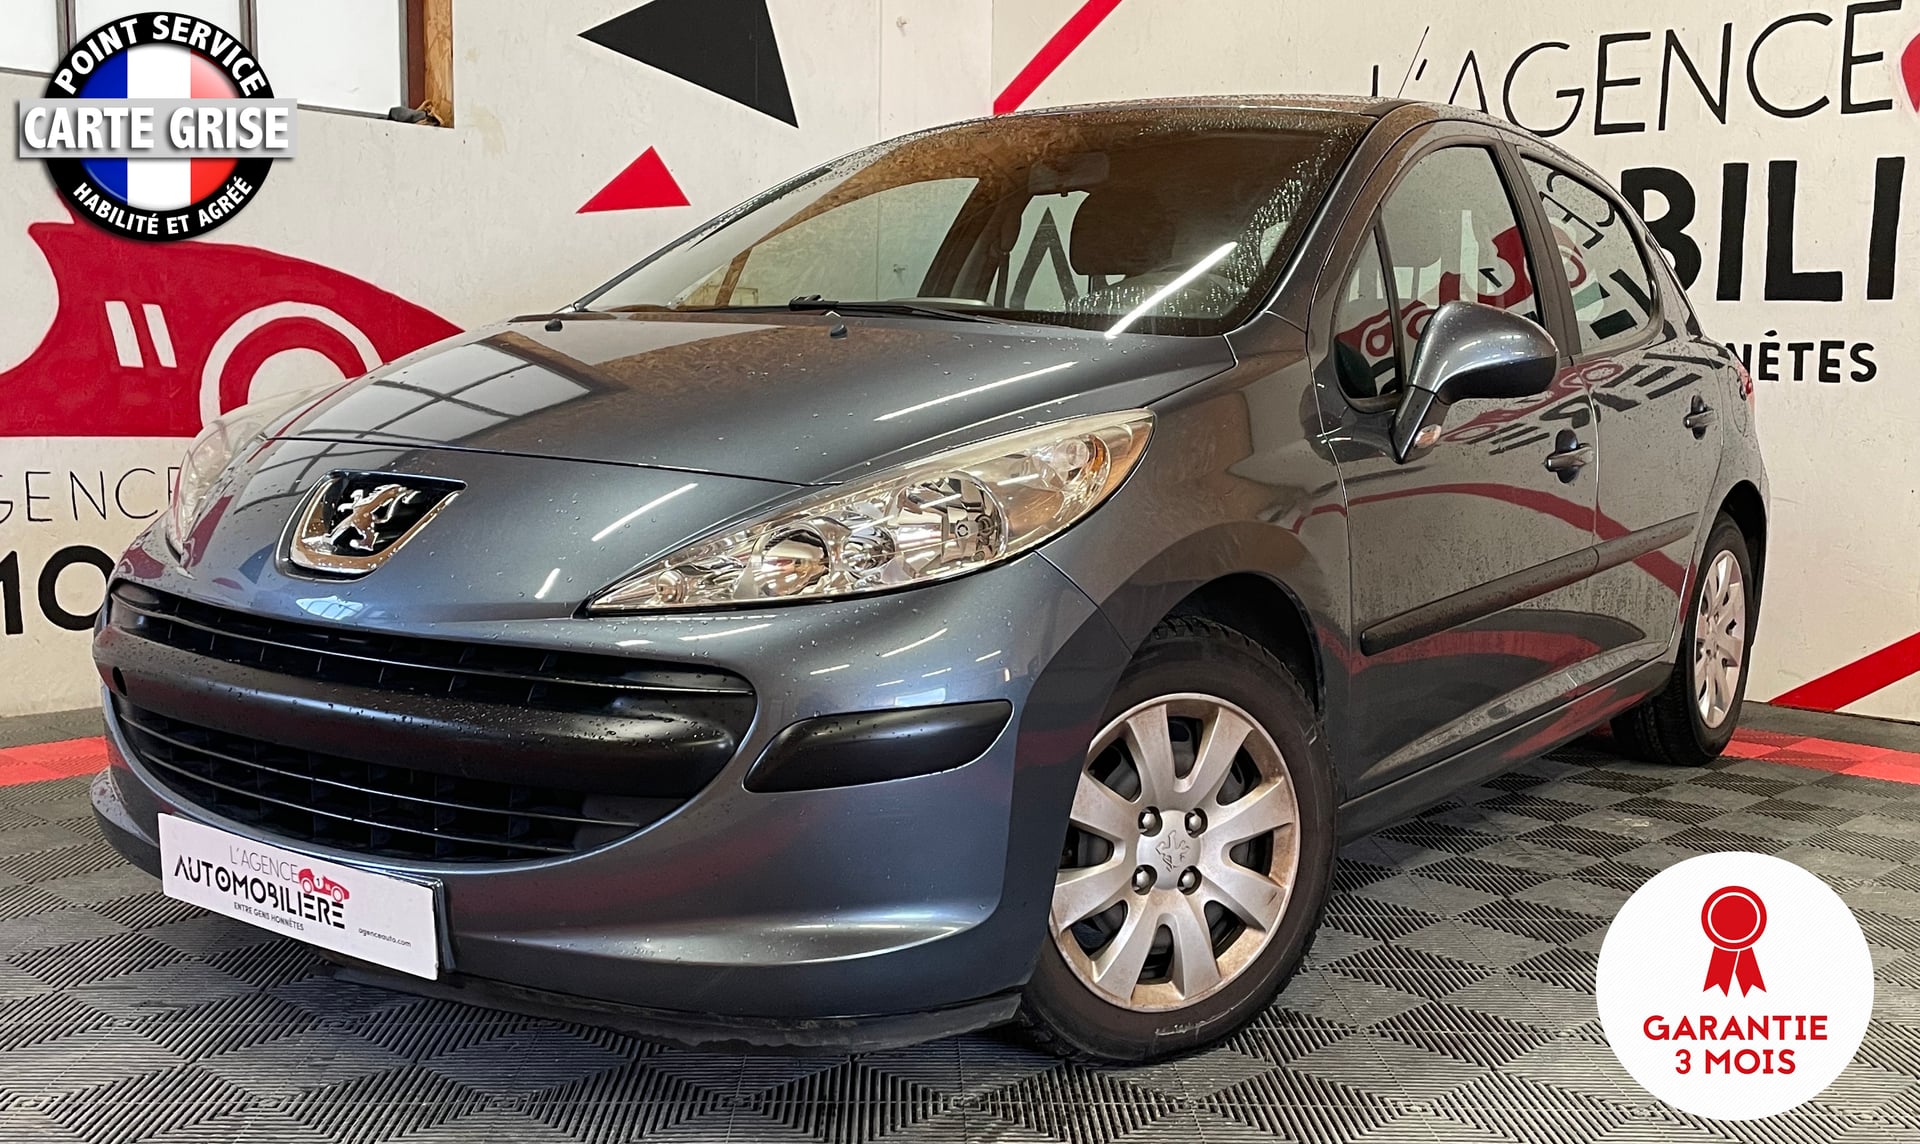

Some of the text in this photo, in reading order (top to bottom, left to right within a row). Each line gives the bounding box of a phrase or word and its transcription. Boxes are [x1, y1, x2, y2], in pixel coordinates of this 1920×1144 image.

[229, 844, 300, 884] L'AGENCE
[234, 901, 253, 915] ENTRE
[254, 908, 270, 920] GENS
[358, 927, 412, 948] agenceauto.com
